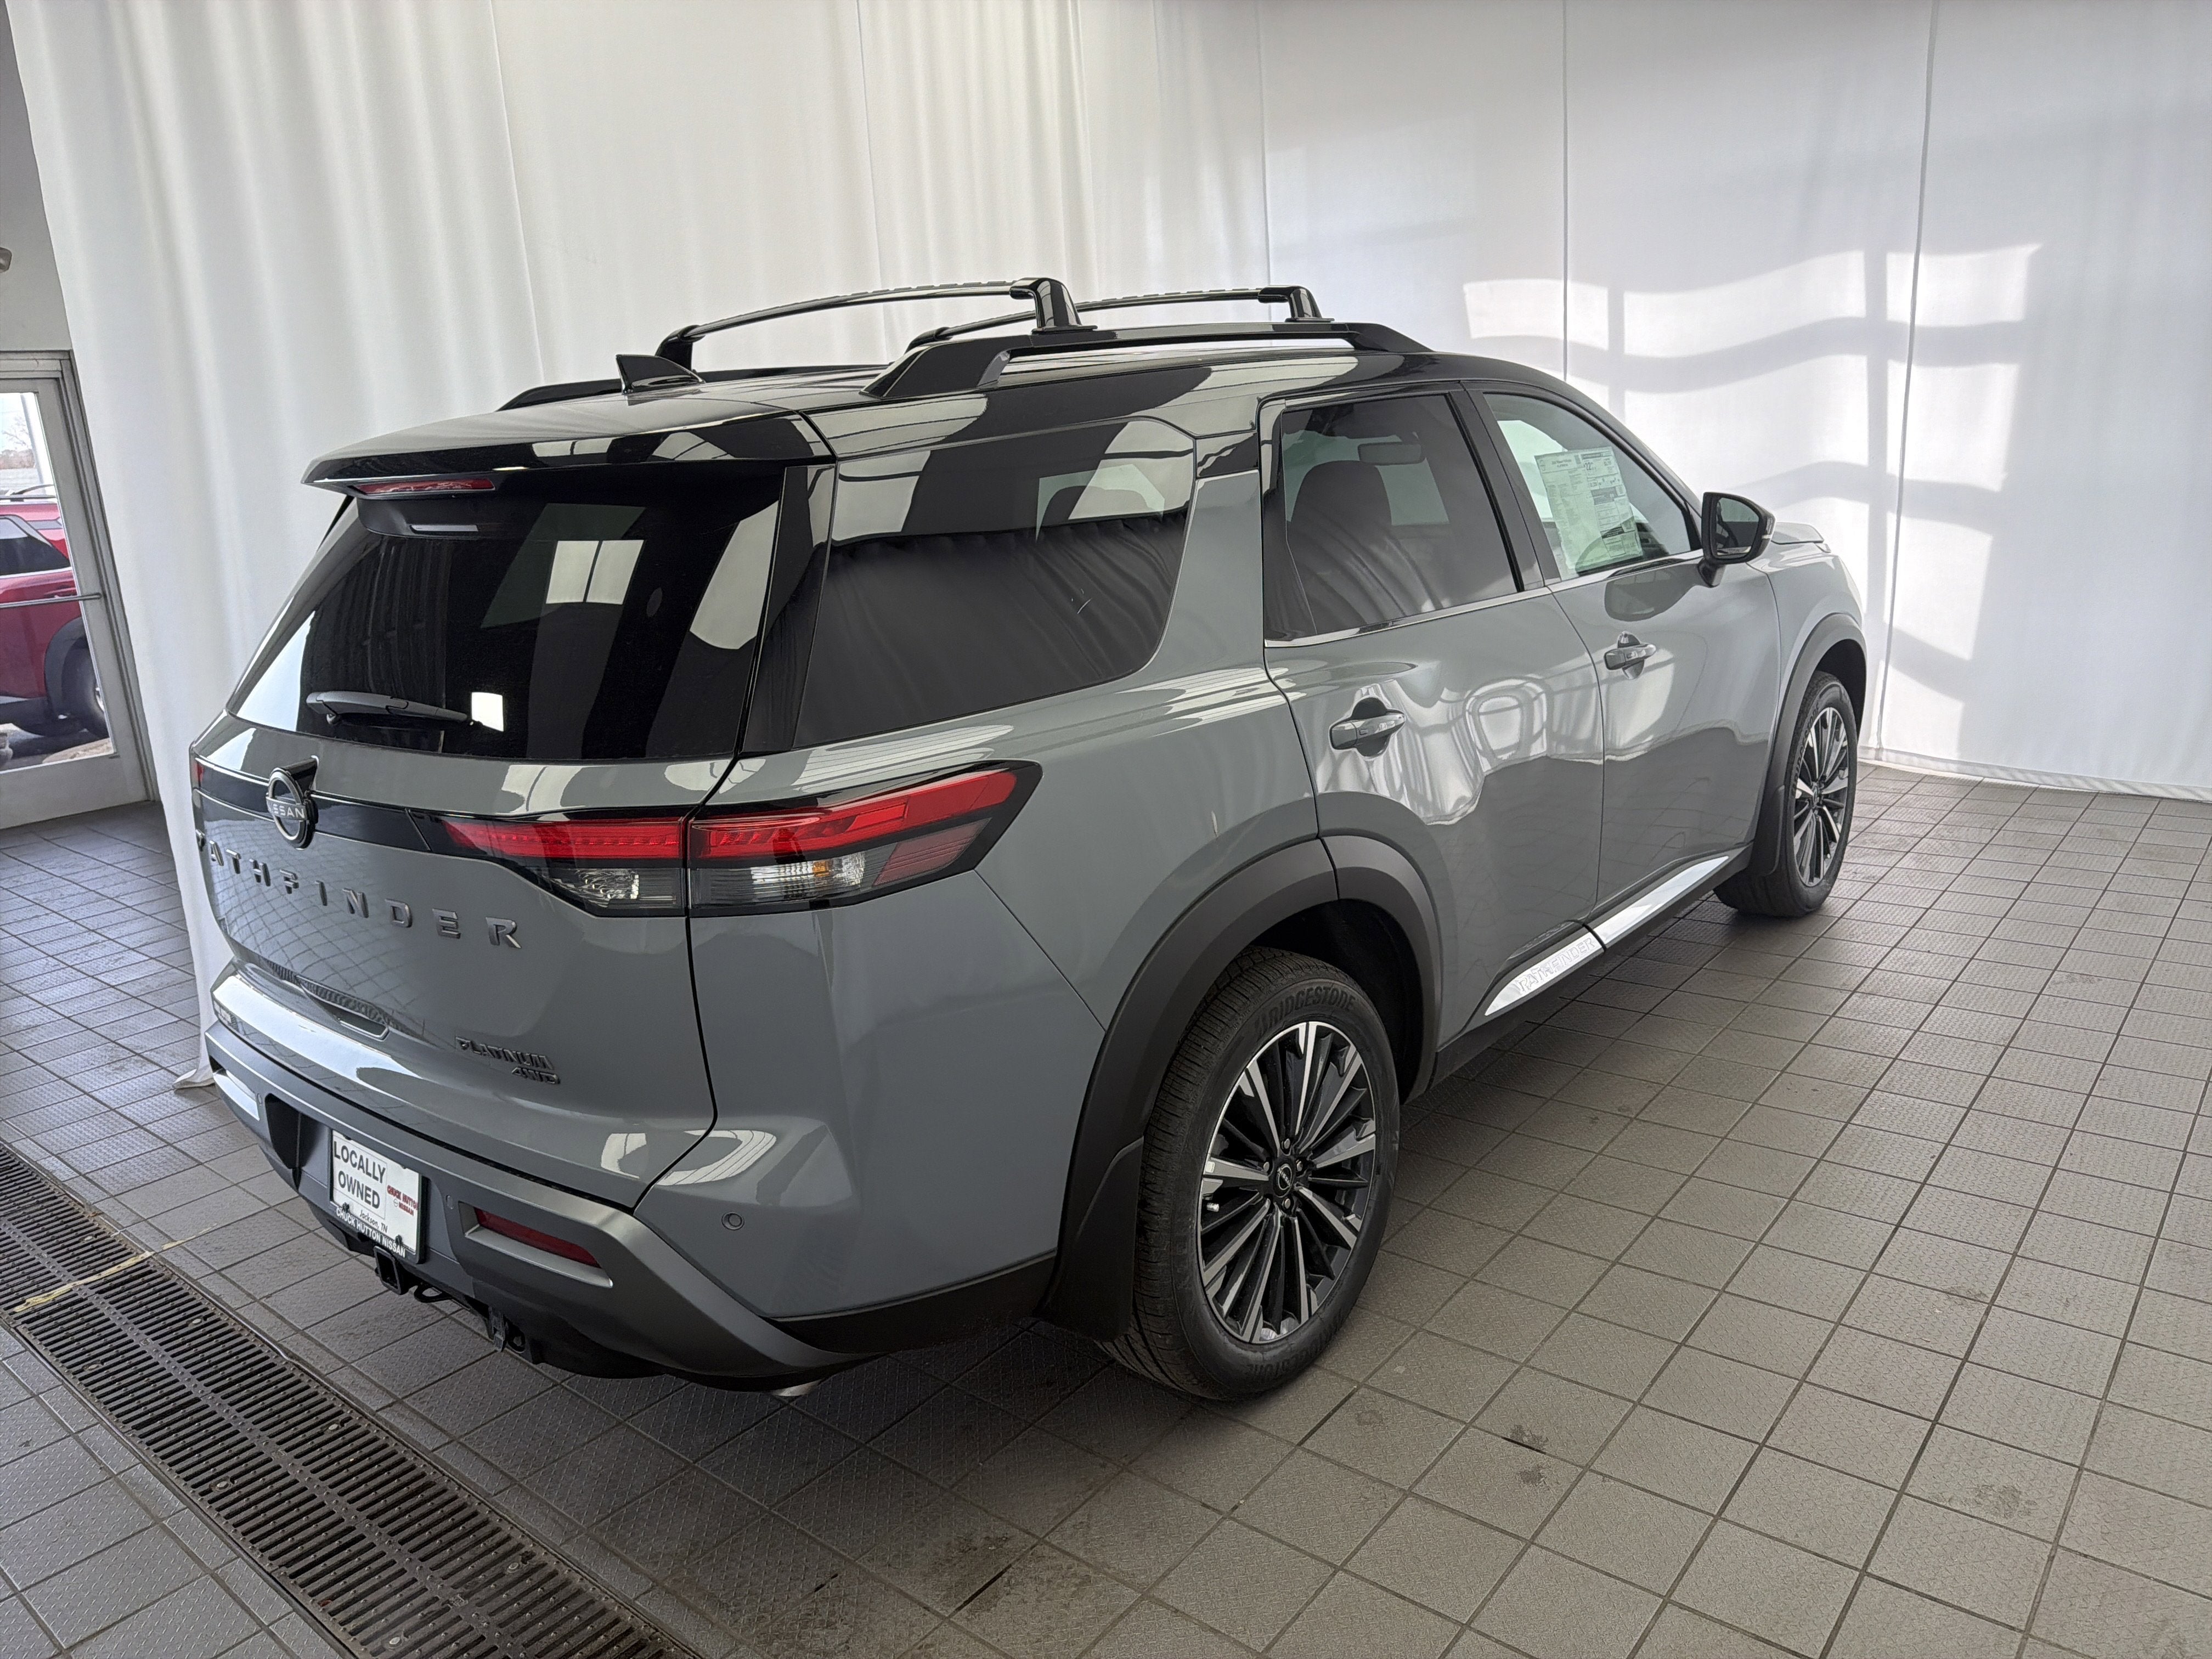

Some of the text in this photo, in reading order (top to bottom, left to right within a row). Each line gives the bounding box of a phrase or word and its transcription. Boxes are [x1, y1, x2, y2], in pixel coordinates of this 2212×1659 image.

[1517, 938, 1595, 993] PATHFINDER
[455, 1035, 553, 1070] PLATINUM
[511, 1066, 561, 1085] 4WD
[334, 1141, 386, 1183] LOCALLY
[338, 1171, 380, 1209] OWNED
[387, 1185, 401, 1200] CHUCK
[336, 1207, 405, 1258] CHUCK HUTTON NISSAN
[360, 1210, 388, 1233] Jackson, TN
